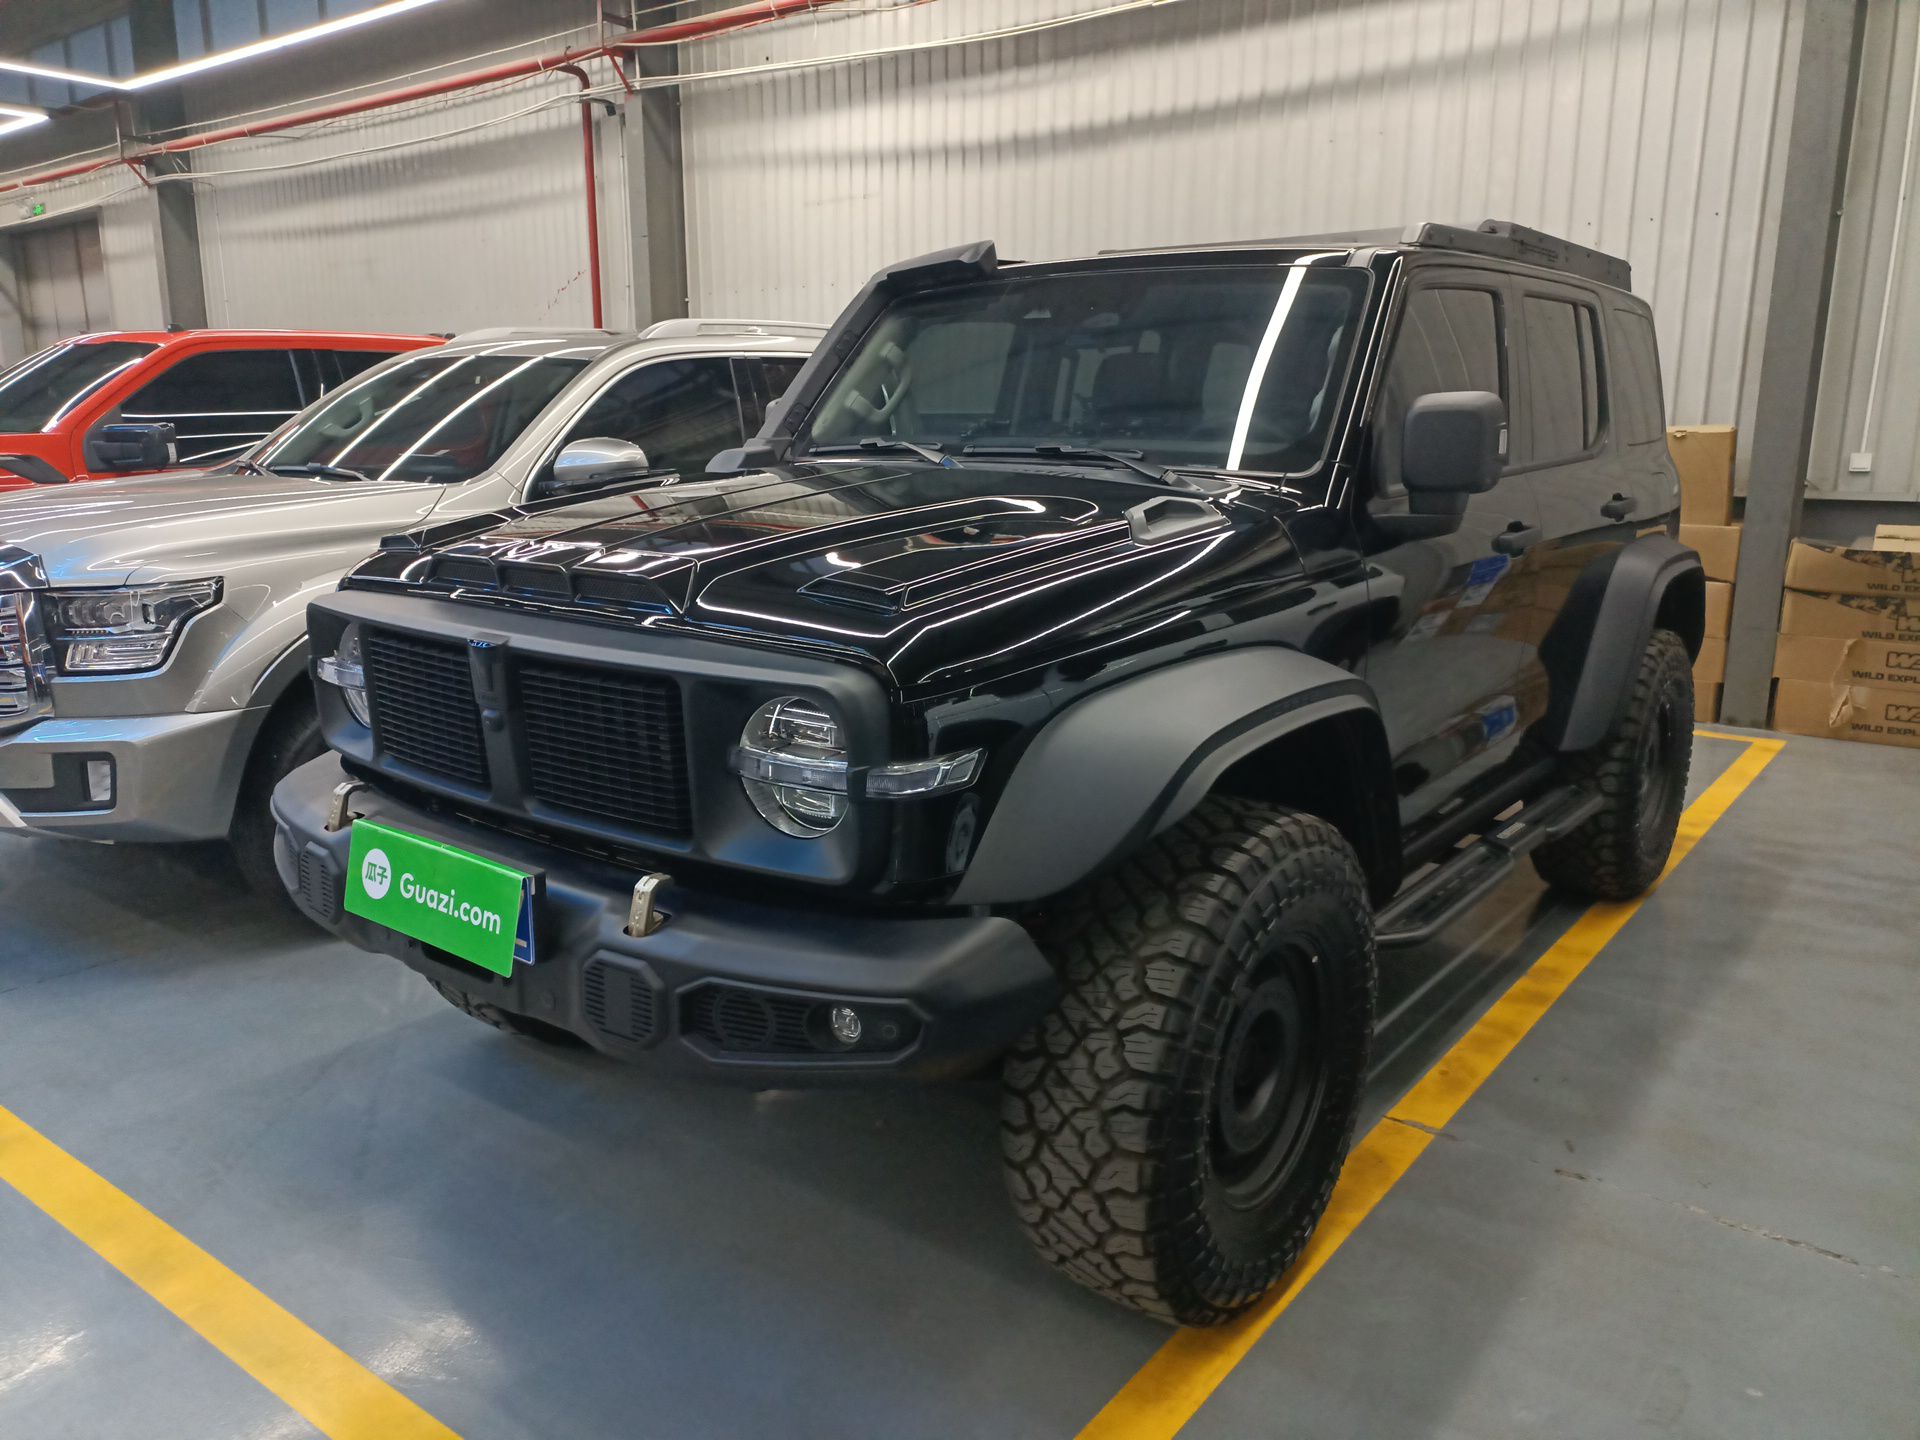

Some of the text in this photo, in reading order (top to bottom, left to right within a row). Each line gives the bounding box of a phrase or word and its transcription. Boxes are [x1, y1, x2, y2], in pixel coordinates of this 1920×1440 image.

[1867, 583, 1900, 591] WILD
[1862, 631, 1895, 640] WILD
[1853, 671, 1884, 680] WILD
[1851, 723, 1883, 733] WILD
[365, 862, 388, 885] 瓜子
[400, 873, 501, 934] Guazi.com
